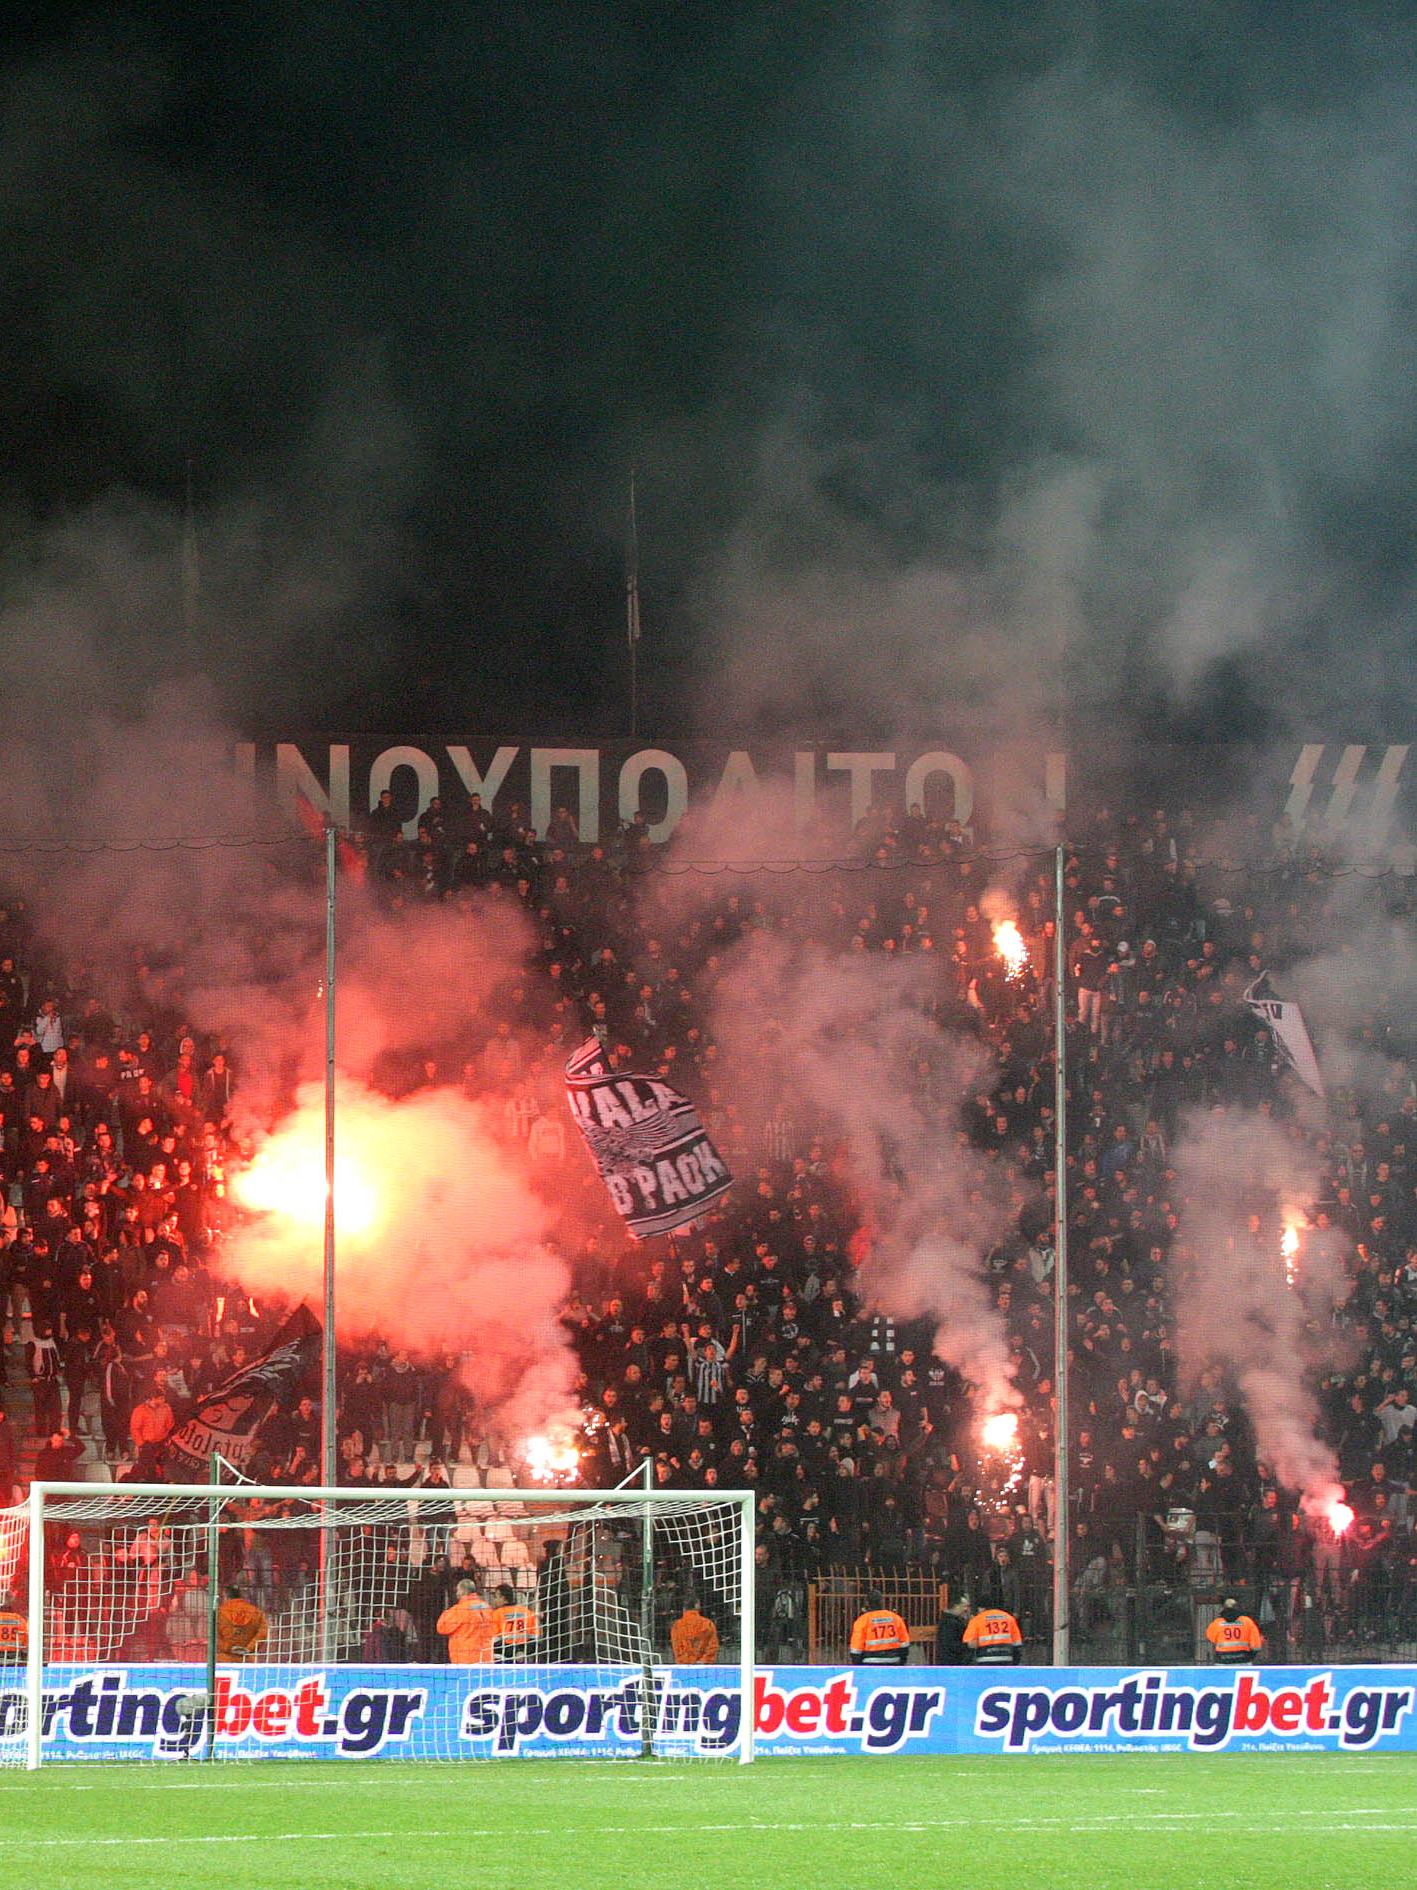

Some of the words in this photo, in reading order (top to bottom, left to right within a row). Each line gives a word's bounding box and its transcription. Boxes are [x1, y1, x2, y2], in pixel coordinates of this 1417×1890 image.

[505, 1618, 525, 1633] 78
[871, 1624, 896, 1640] 173
[984, 1620, 1010, 1635] 132
[1223, 1626, 1242, 1640] 90
[980, 1675, 1410, 1747] sportingbet.gr
